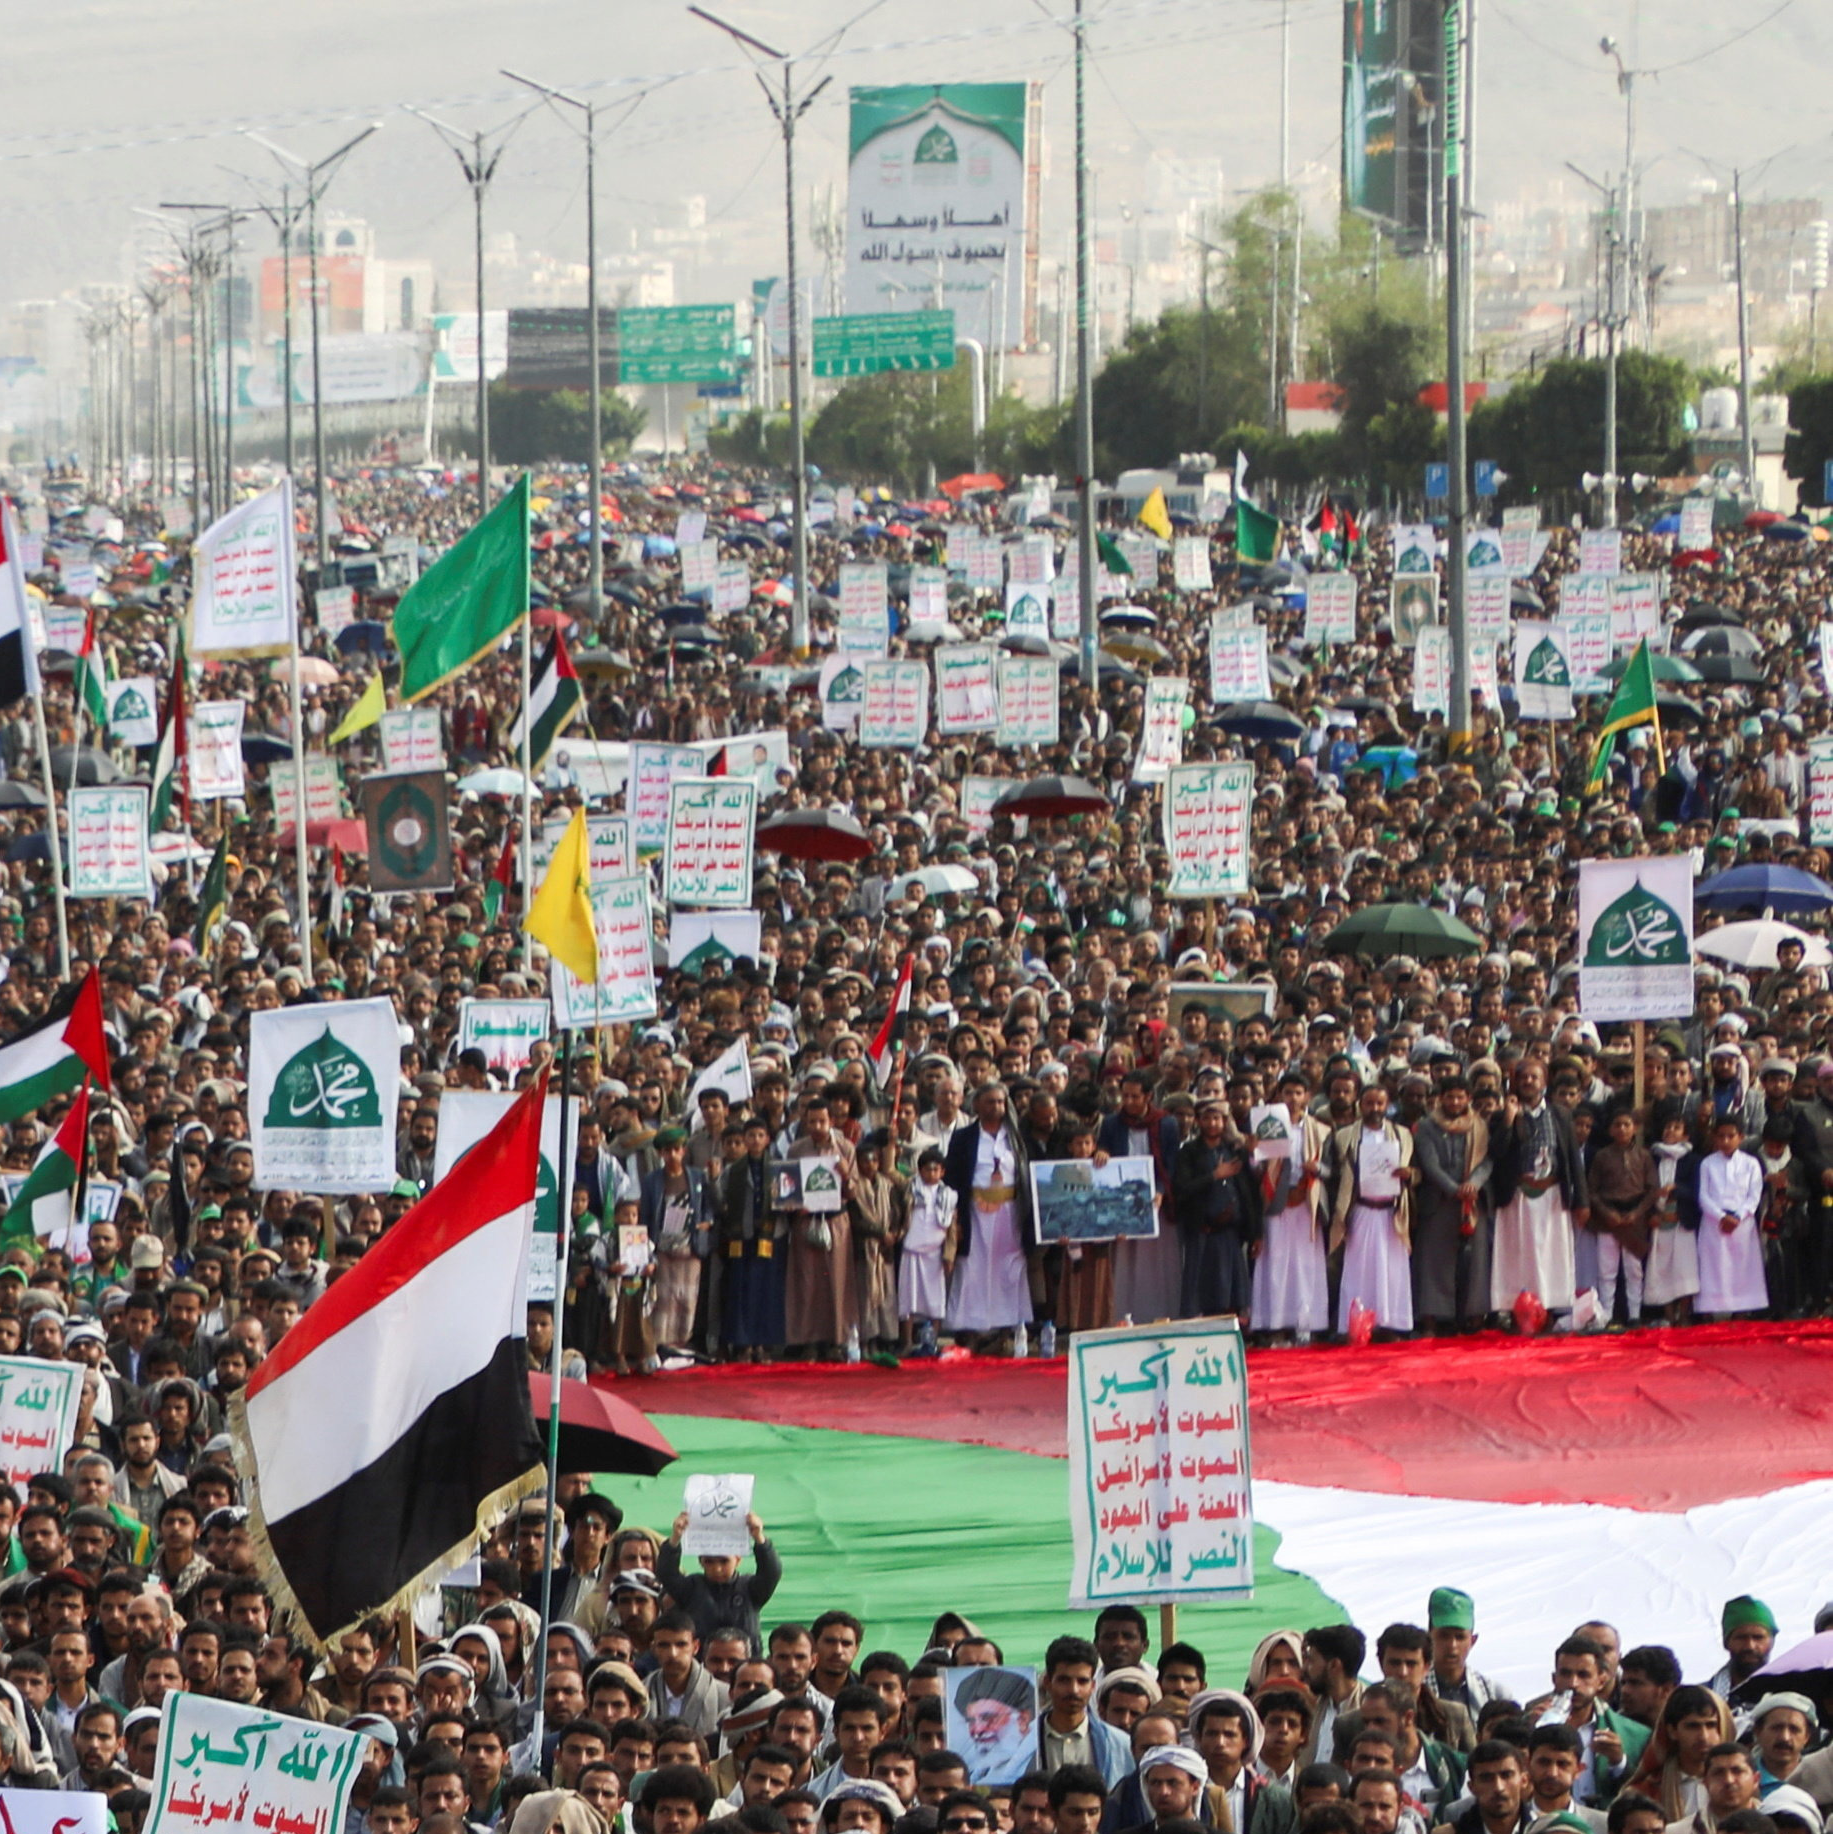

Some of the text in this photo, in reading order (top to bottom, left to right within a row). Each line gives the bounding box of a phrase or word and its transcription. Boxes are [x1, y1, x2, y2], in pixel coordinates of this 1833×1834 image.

[1093, 1346, 1238, 1408] الله أكبر
[1094, 1401, 1239, 1443] الموت لأمريكا
[1097, 1451, 1242, 1493] الموت لإسرائيل
[1100, 1493, 1245, 1534] اللعنة على اليهود
[1095, 1534, 1247, 1586] النصر للإسلام
[175, 1714, 348, 1783] الله أكبر
[167, 1780, 250, 1826] لأمريكا
